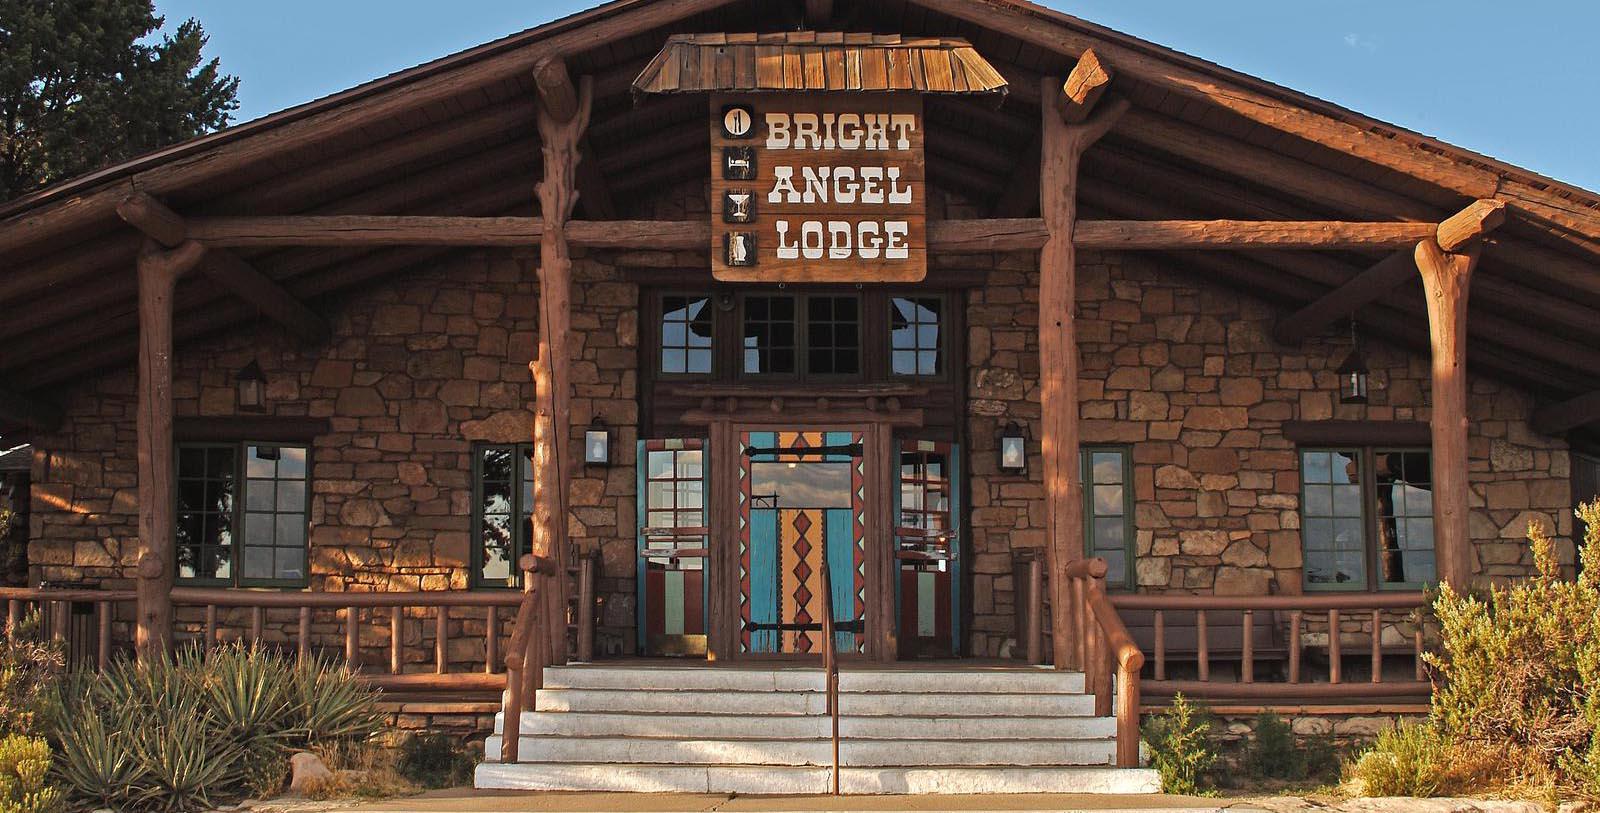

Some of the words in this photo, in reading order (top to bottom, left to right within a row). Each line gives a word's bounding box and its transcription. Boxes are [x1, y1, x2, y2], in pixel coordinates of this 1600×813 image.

[765, 113, 915, 150] BRIGHT
[768, 166, 912, 204] ANGEL
[775, 220, 909, 259] LODGE
